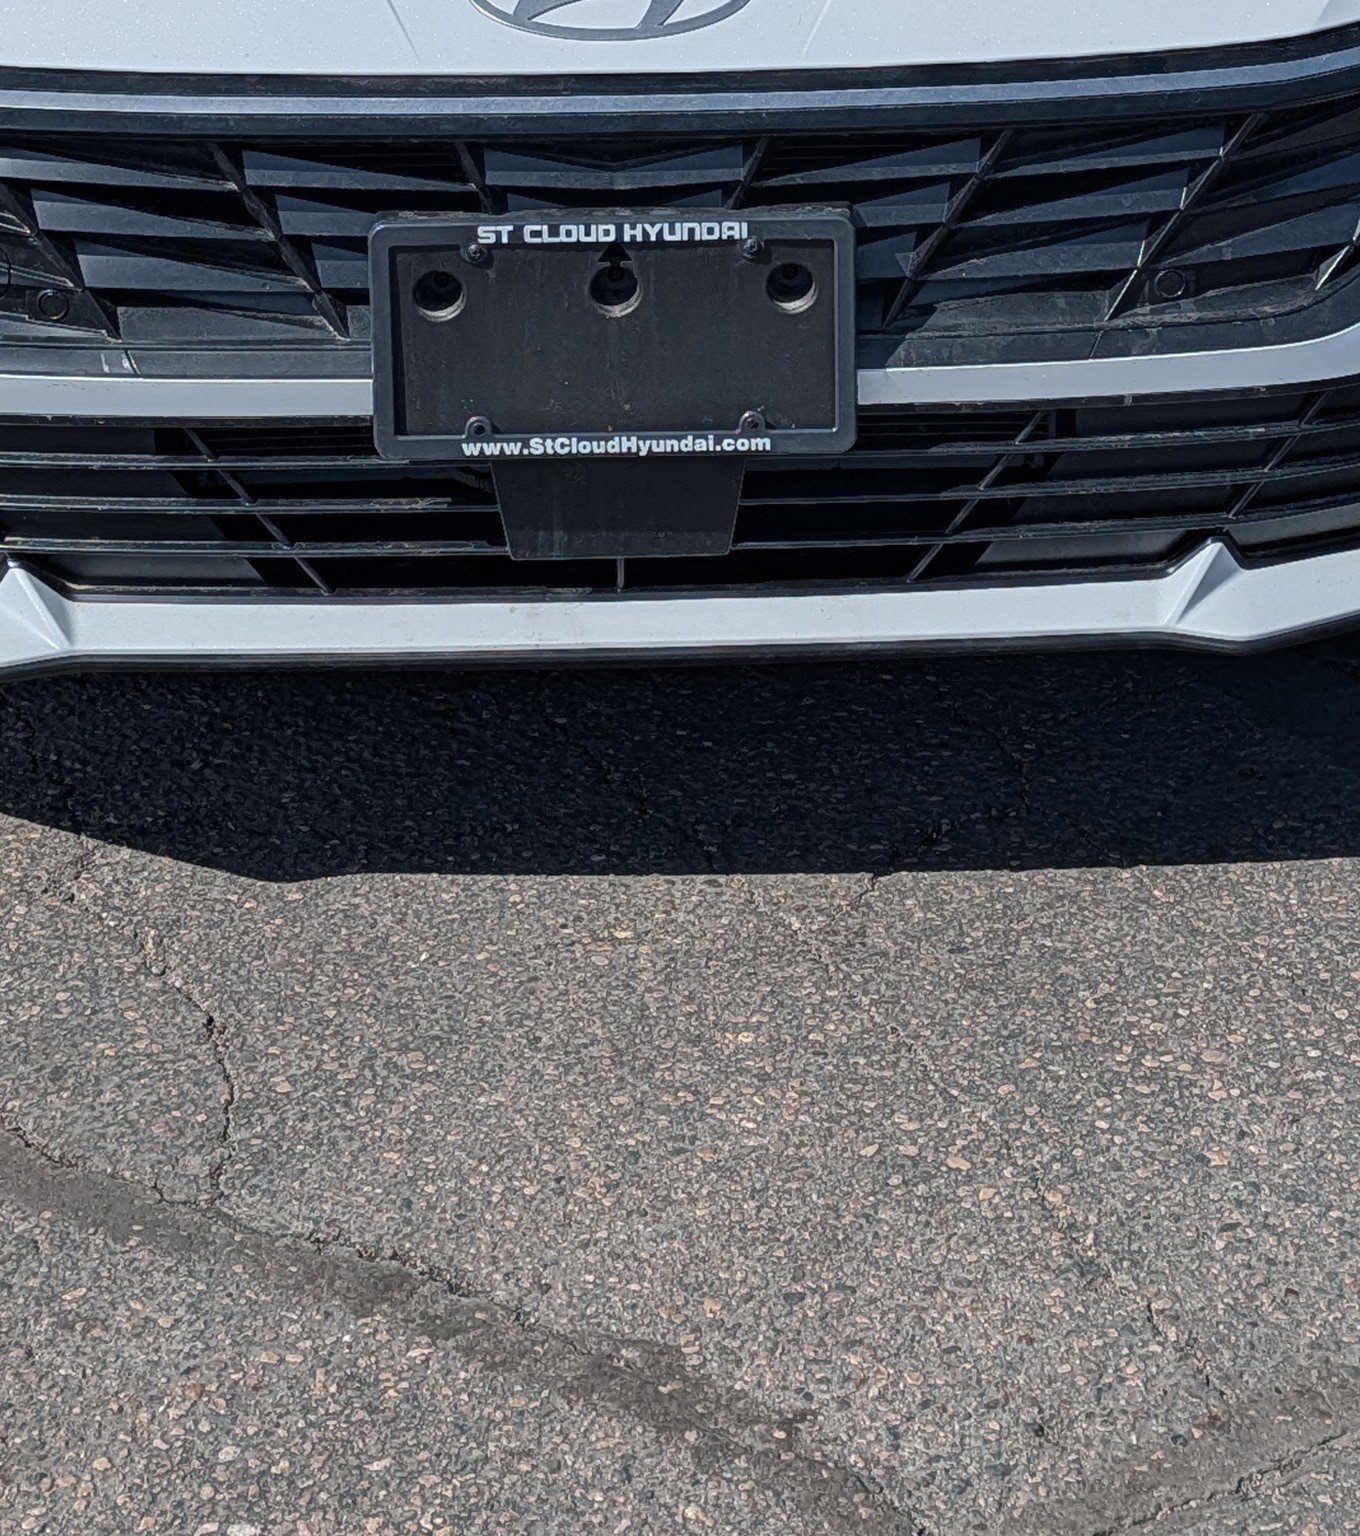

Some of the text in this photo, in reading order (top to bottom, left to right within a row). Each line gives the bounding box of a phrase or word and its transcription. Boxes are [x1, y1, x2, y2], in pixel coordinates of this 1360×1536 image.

[476, 221, 749, 244] ST CLOUD HYUNDAI
[461, 434, 772, 456] www.StCloudHyundai.com
